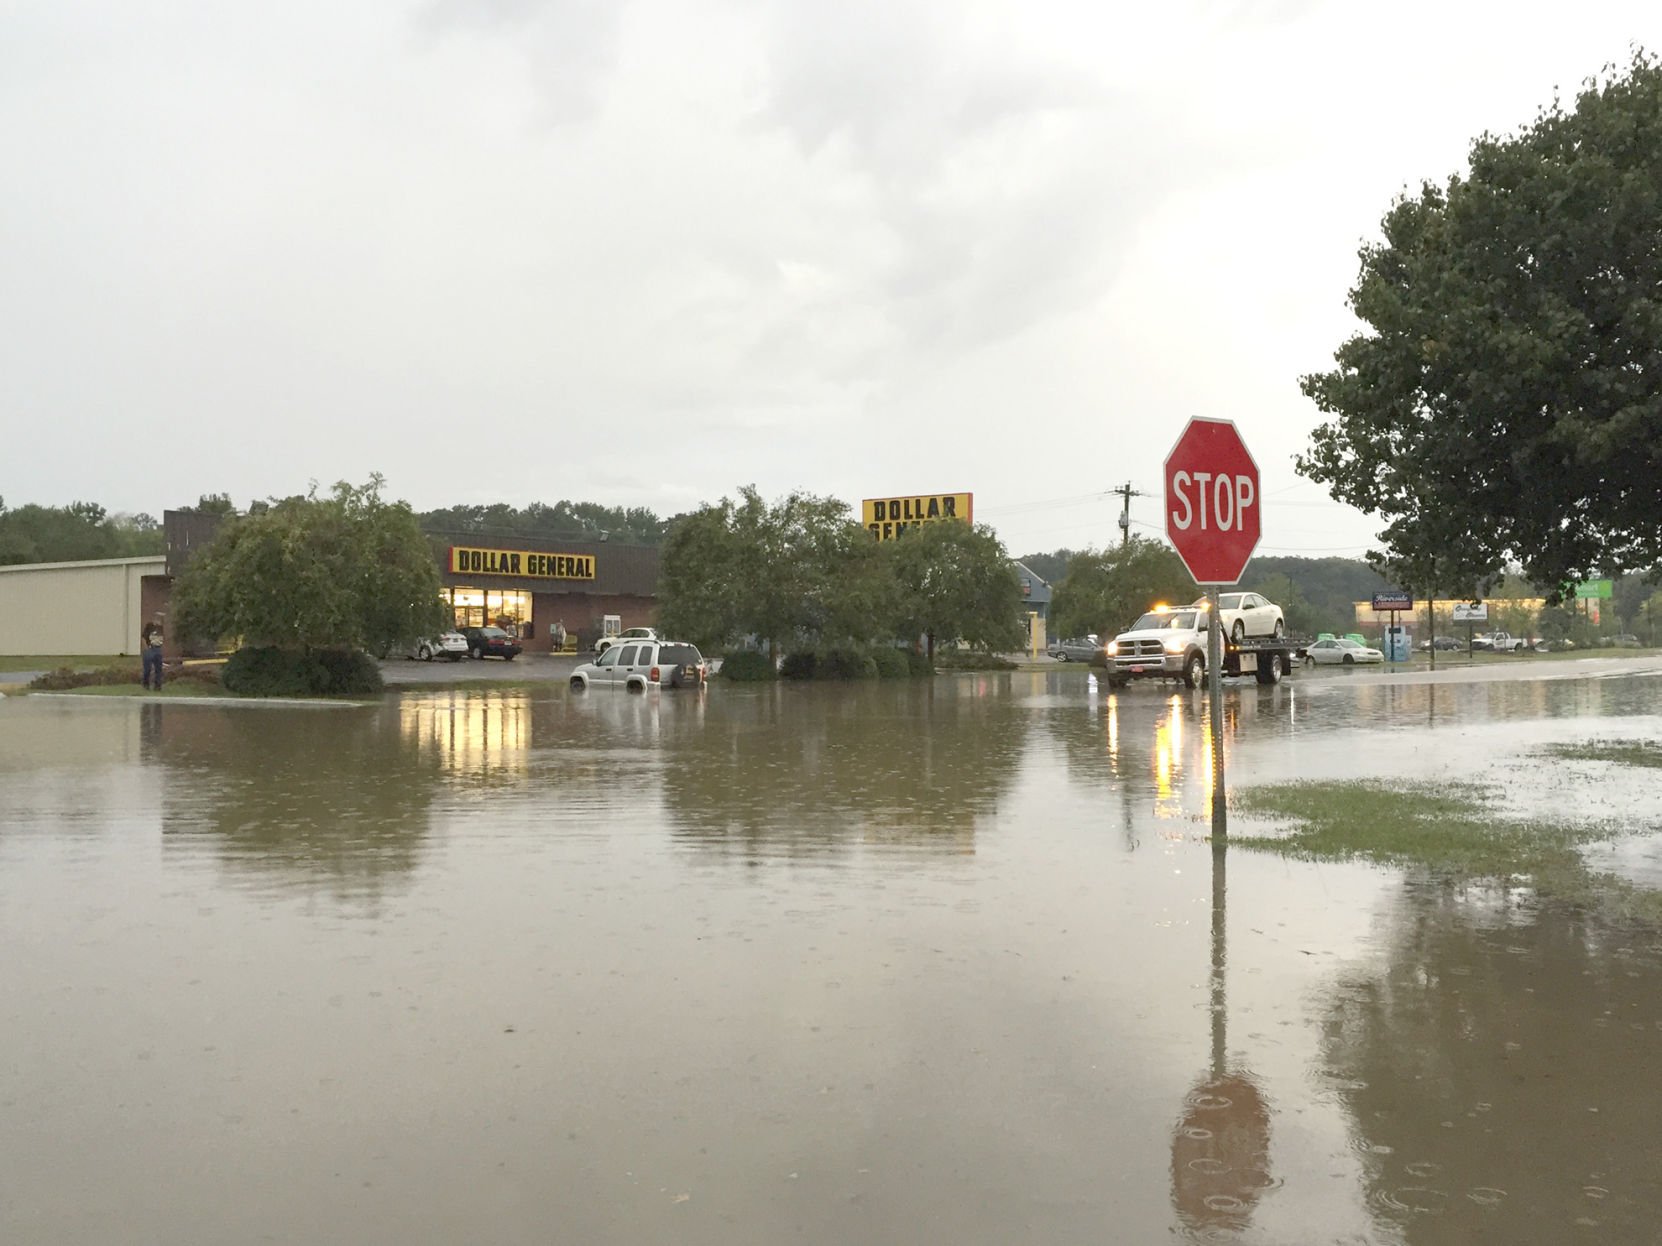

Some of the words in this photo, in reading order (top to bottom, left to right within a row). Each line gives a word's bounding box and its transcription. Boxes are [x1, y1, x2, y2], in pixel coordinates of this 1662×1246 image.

[873, 496, 956, 521] DOLLAR
[1172, 470, 1255, 532] STOP
[458, 550, 521, 574] DOLLAR
[527, 554, 593, 577] GENERAL
